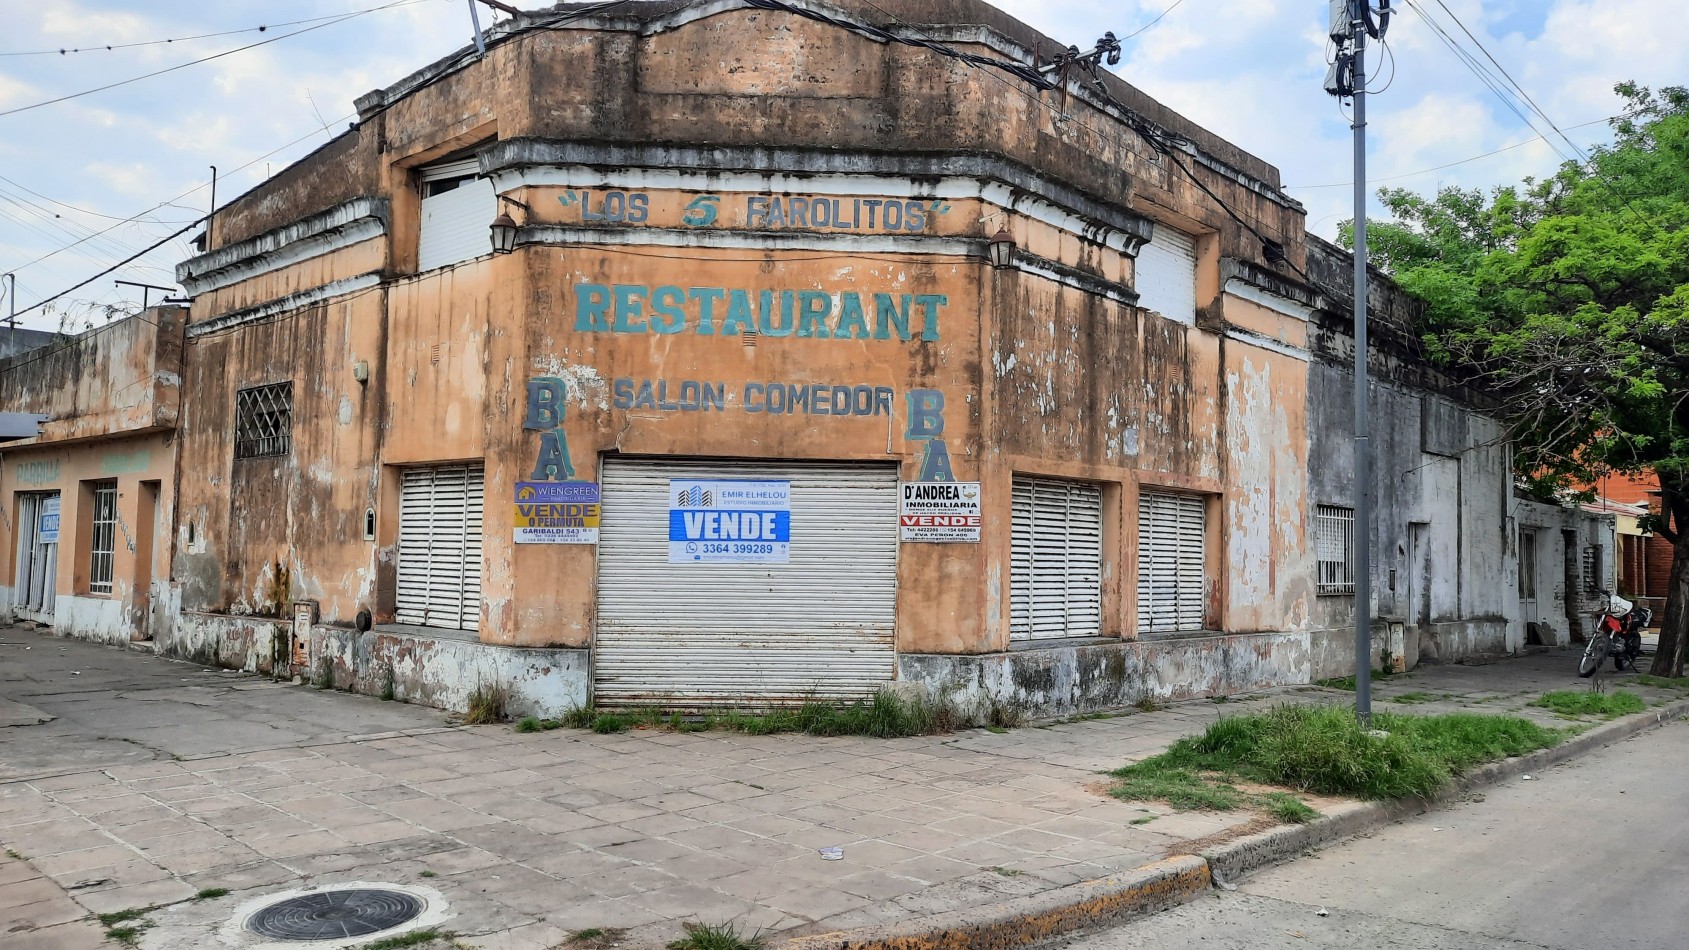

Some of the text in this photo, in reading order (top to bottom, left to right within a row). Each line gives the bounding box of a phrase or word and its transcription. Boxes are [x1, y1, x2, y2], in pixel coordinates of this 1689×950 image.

[682, 195, 721, 227] 5
[573, 283, 948, 342] RESTAURANT
[612, 377, 894, 416] SALON COMEDOR
[538, 486, 598, 496] WIENGREEN
[746, 491, 786, 499] ELHELOU
[518, 504, 598, 517] VENDE
[538, 517, 584, 527] PERMUTA
[683, 511, 777, 540] VENDE
[902, 516, 980, 526] VENDE
[703, 543, 773, 554] 3364 399289
